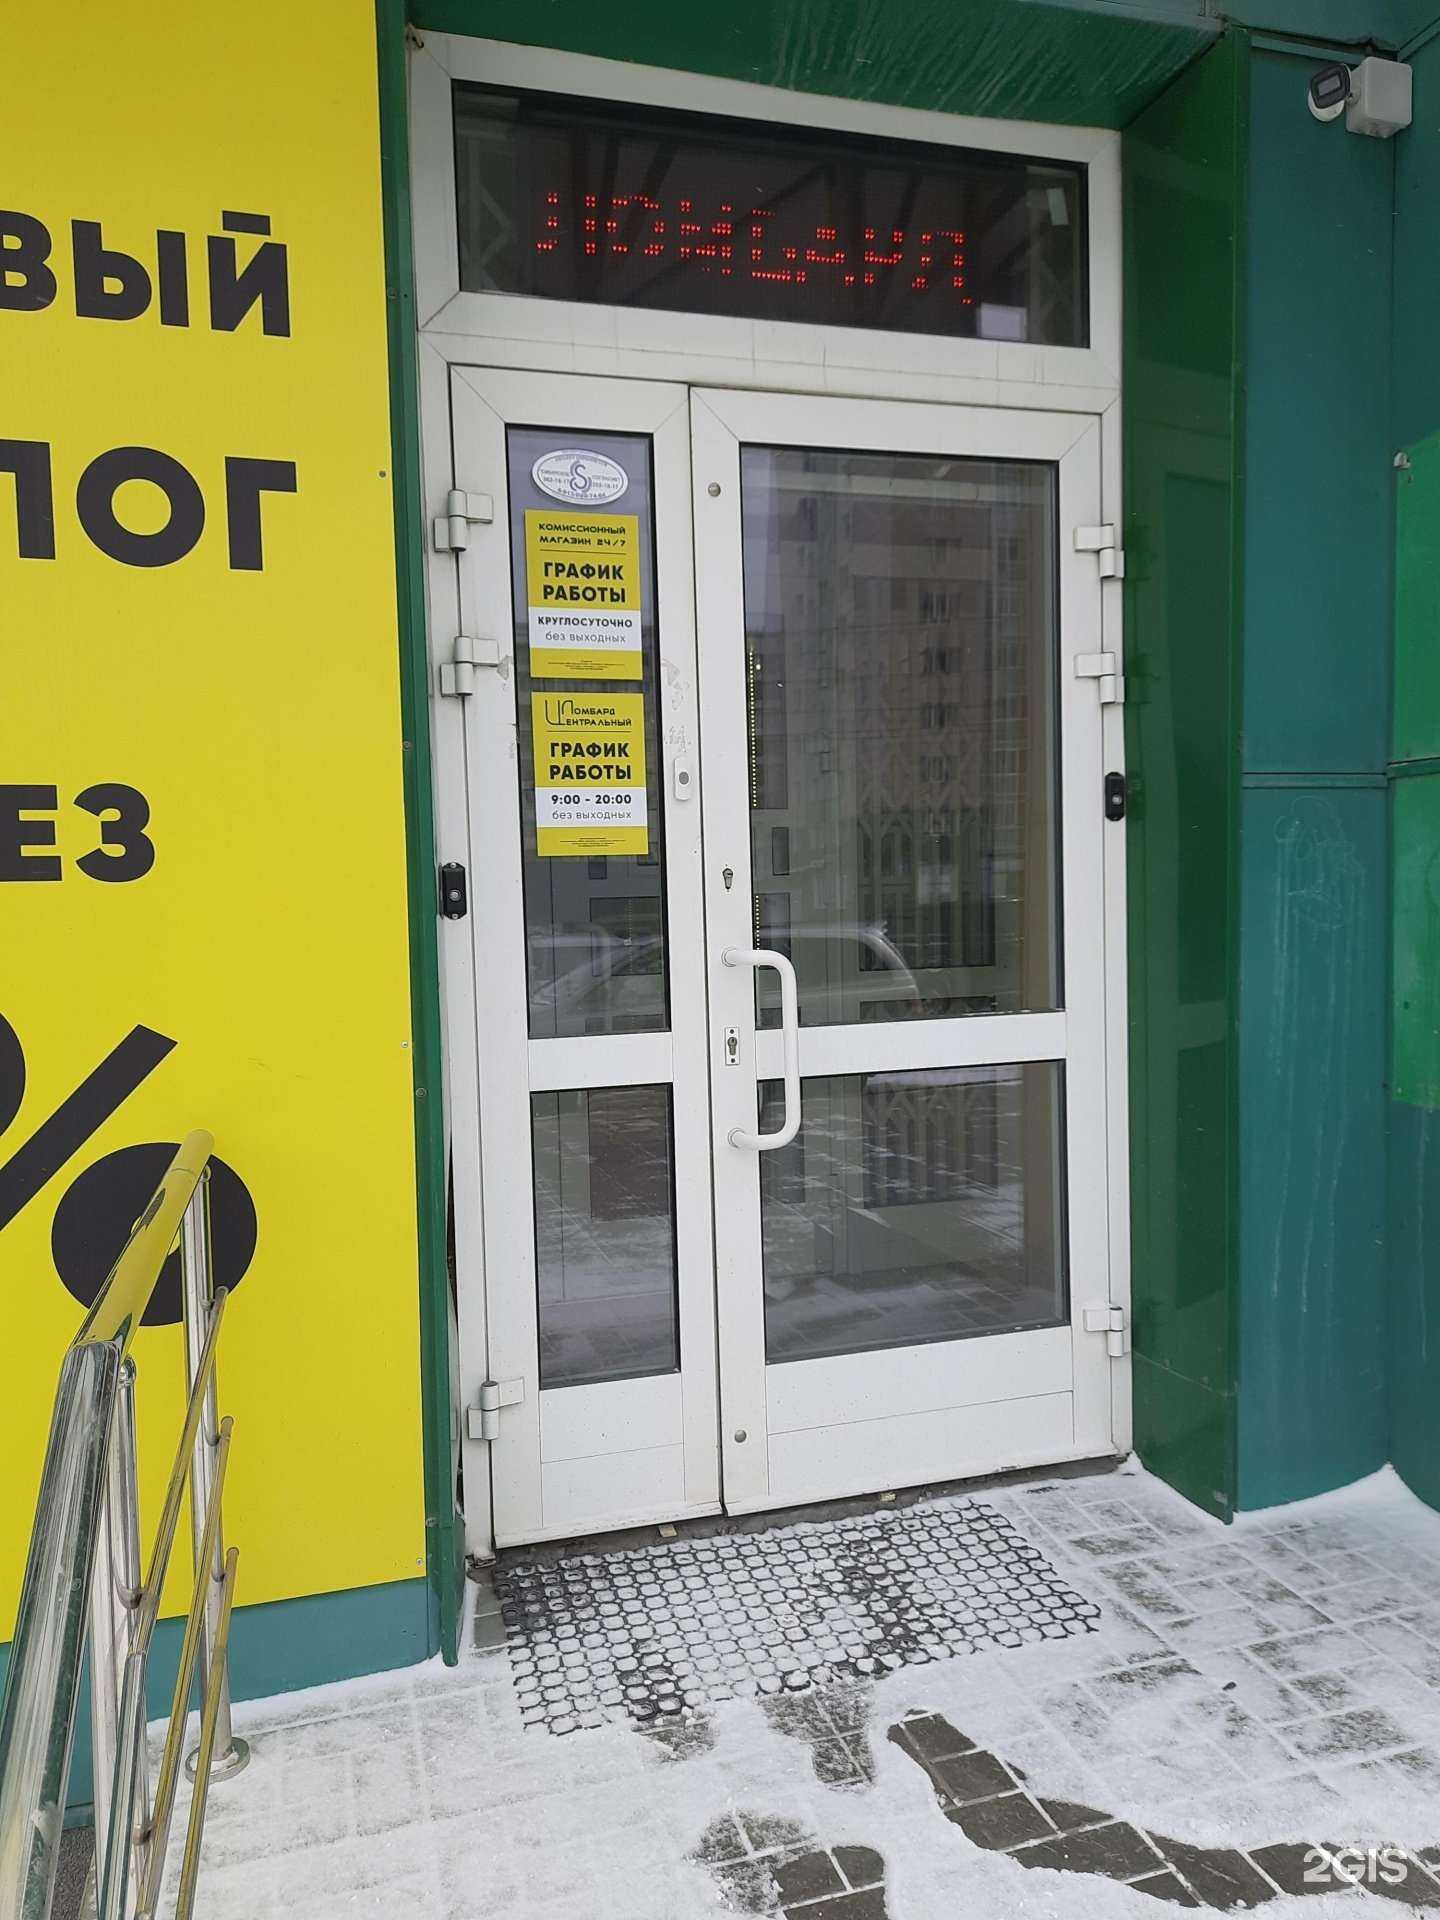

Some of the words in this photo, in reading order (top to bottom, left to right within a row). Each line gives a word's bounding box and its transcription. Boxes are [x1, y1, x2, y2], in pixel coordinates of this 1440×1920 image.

[538, 523, 626, 535] КОМИССИОННЫЙ
[539, 536, 592, 546] МАГАЗИН
[596, 538, 626, 547] 24/7
[543, 562, 624, 580] ГРАФИК
[543, 584, 626, 603] РАБОТЫ
[537, 616, 633, 628] КРУГЛОСУТОЧНО
[545, 630, 566, 641] без
[569, 633, 626, 644] выходных
[550, 742, 629, 758] ГРАФИК
[549, 764, 632, 780] РАБОТЫ
[551, 794, 581, 805] 9:00
[595, 794, 632, 805] 20:00
[552, 810, 572, 821] без
[576, 812, 632, 822] выходных
